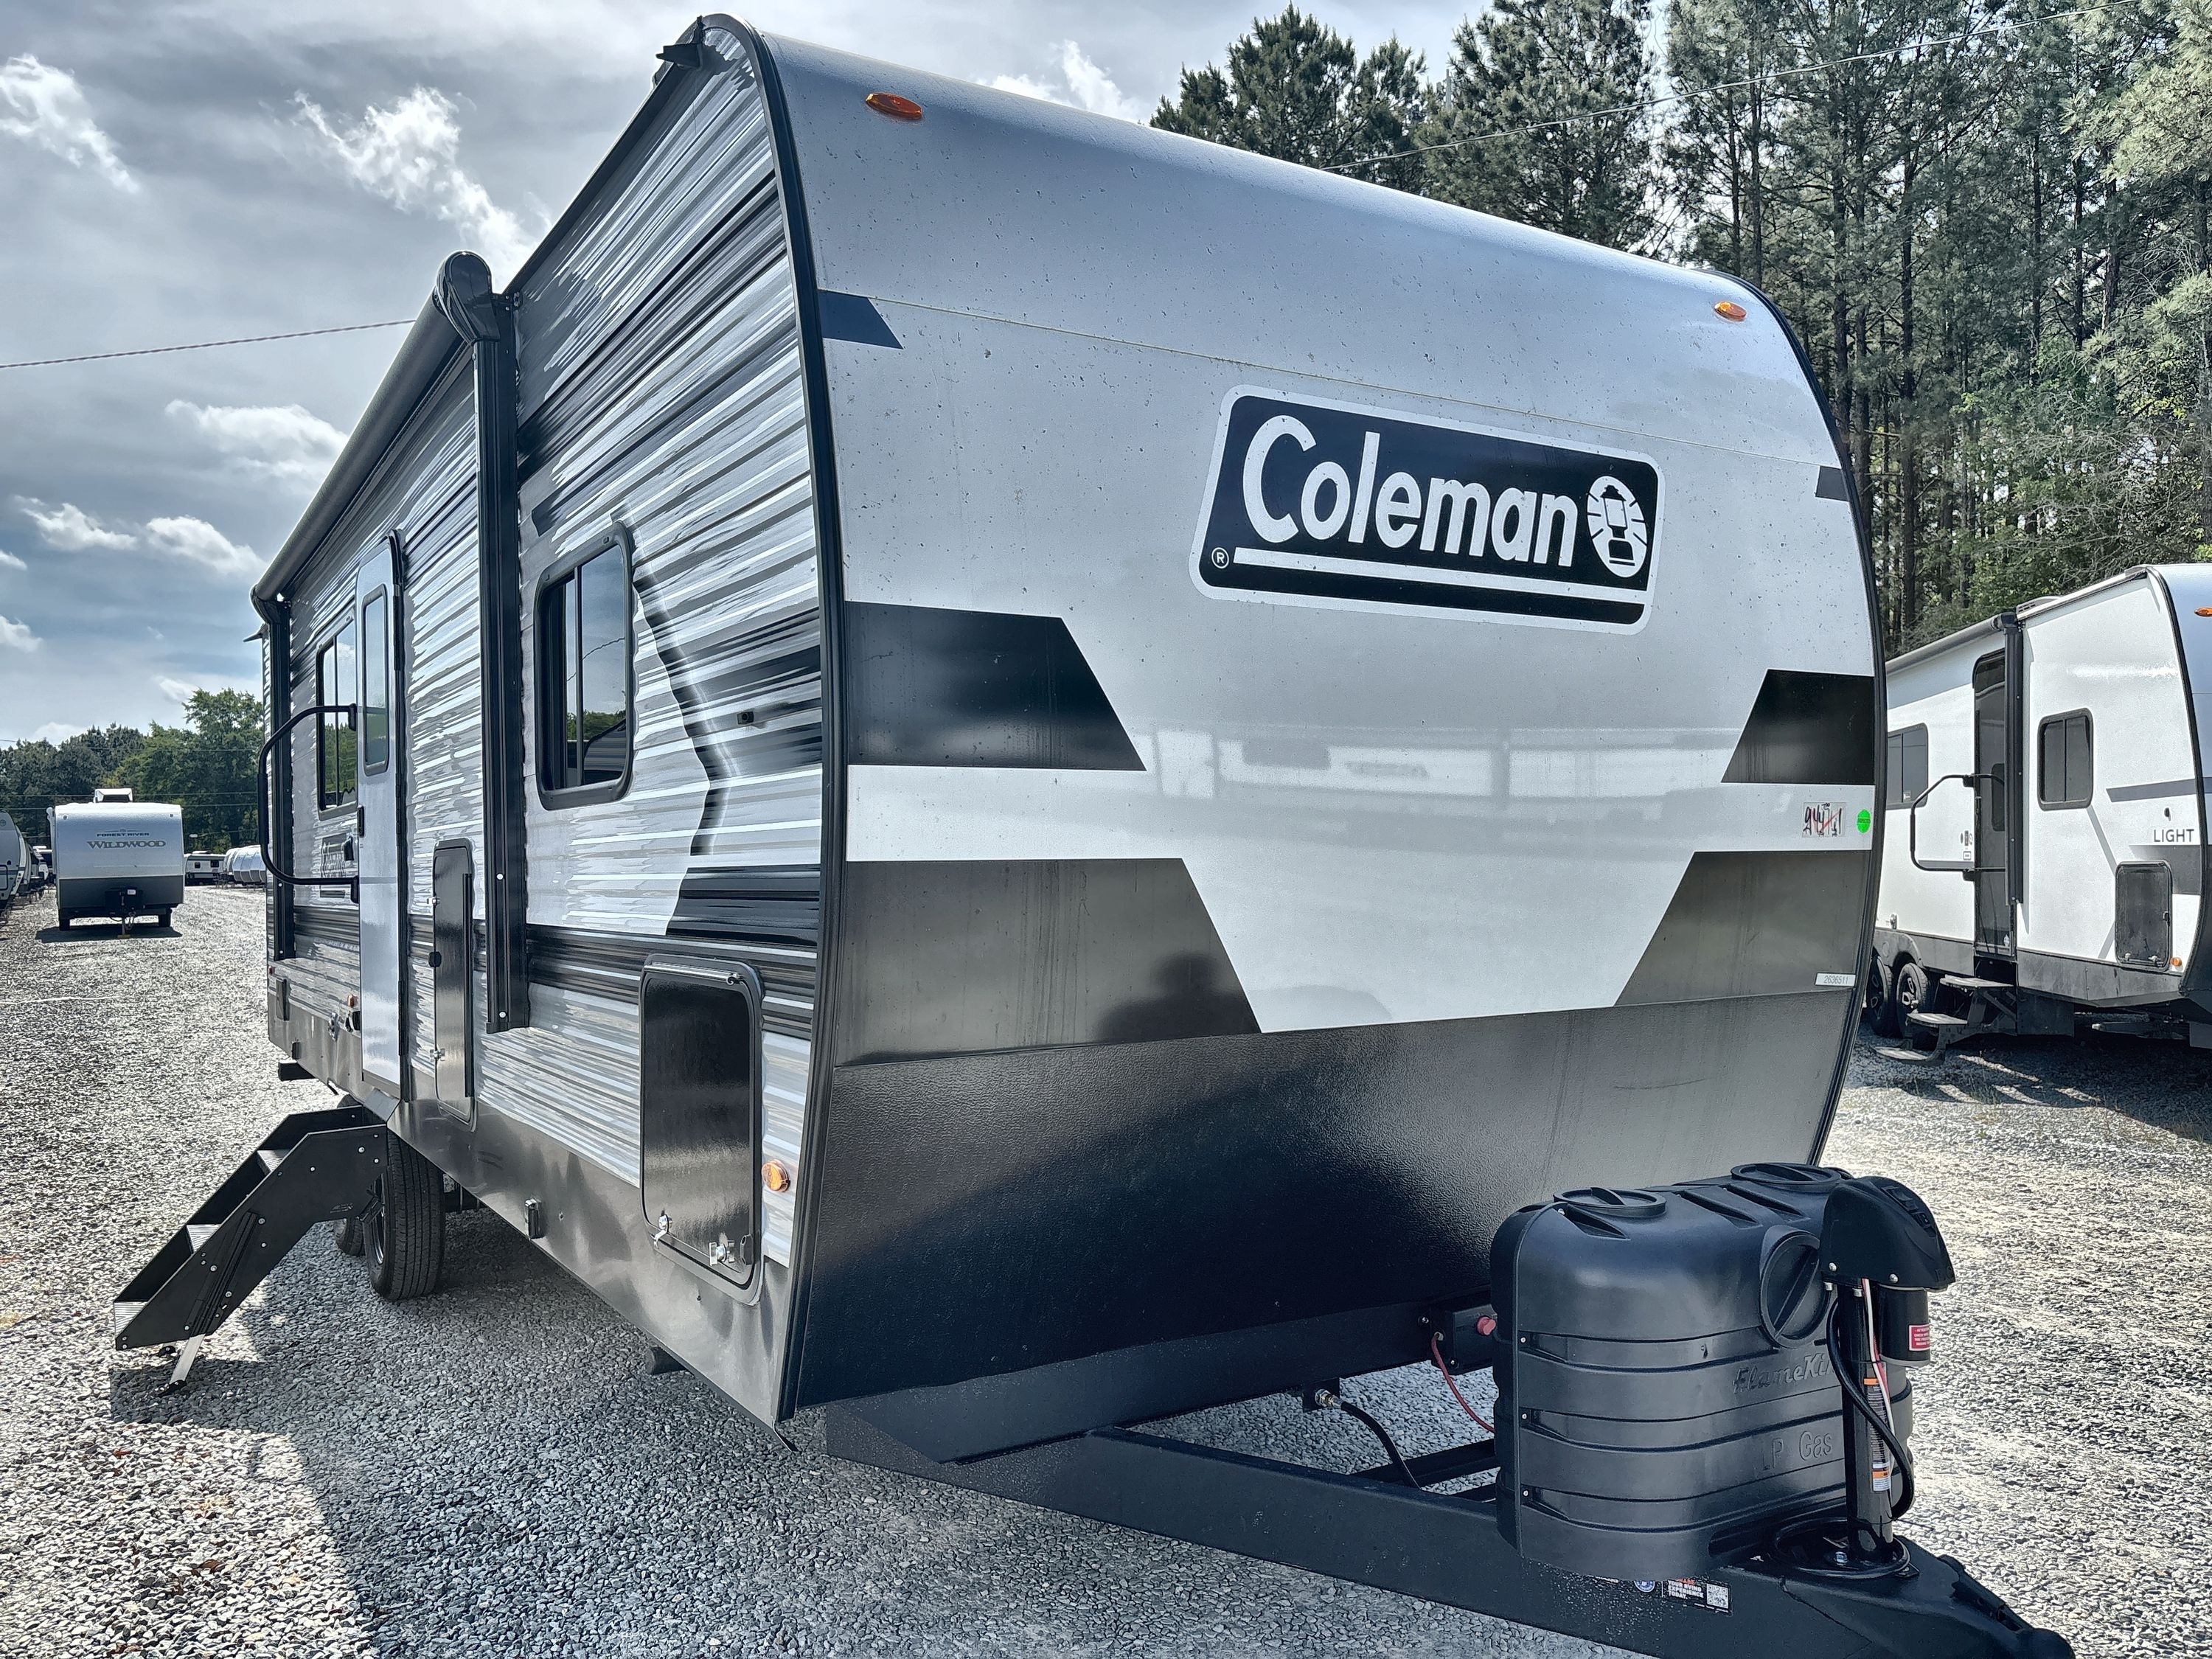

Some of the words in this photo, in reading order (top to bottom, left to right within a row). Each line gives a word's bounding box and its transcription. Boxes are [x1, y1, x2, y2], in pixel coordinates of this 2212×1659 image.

[1242, 414, 1579, 567] Coleman
[2153, 828, 2195, 843] LIGHT
[86, 841, 167, 849] WILDWOOD
[1799, 1430, 1833, 1461] Gas
[1667, 1579, 1683, 1588] YOUR
[1667, 1585, 1704, 1599] EXPERIENCE
